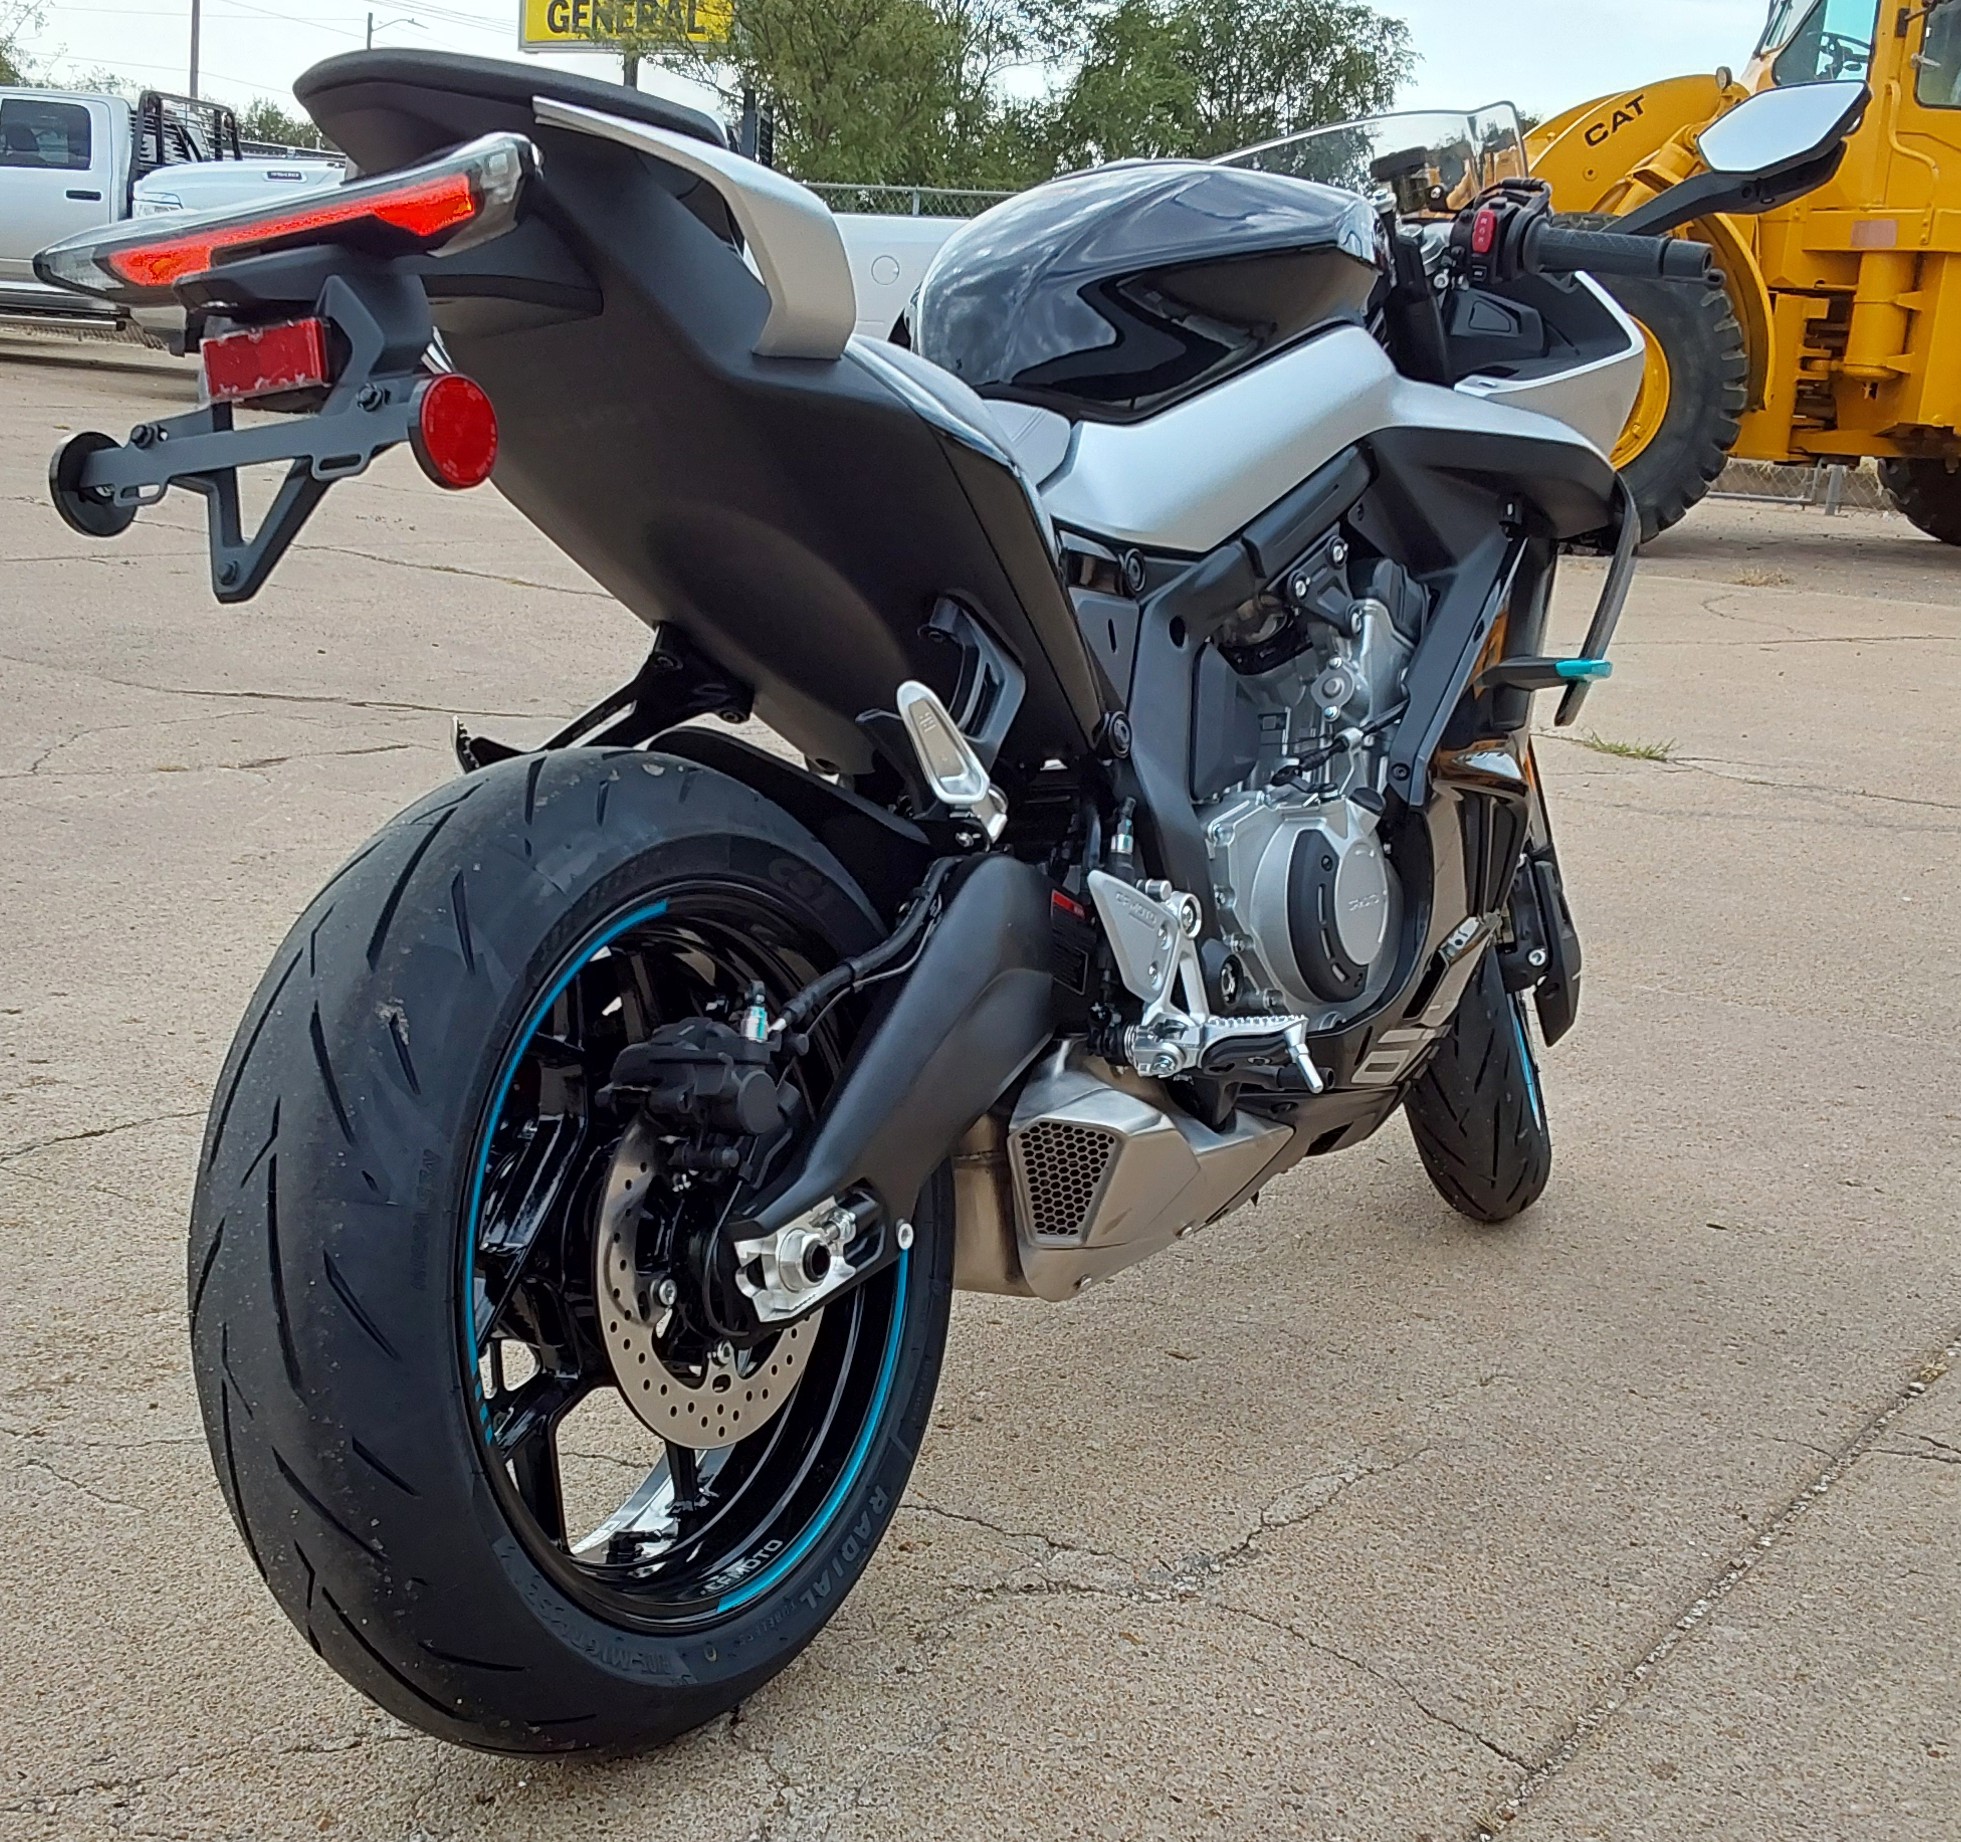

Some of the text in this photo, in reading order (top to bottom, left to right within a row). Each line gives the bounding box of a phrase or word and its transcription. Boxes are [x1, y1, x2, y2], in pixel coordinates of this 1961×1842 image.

[547, 0, 705, 34] GENERAL
[1584, 93, 1645, 147] CAT
[705, 1539, 784, 1592] CFMOTO
[800, 1485, 890, 1609] RADIAL
